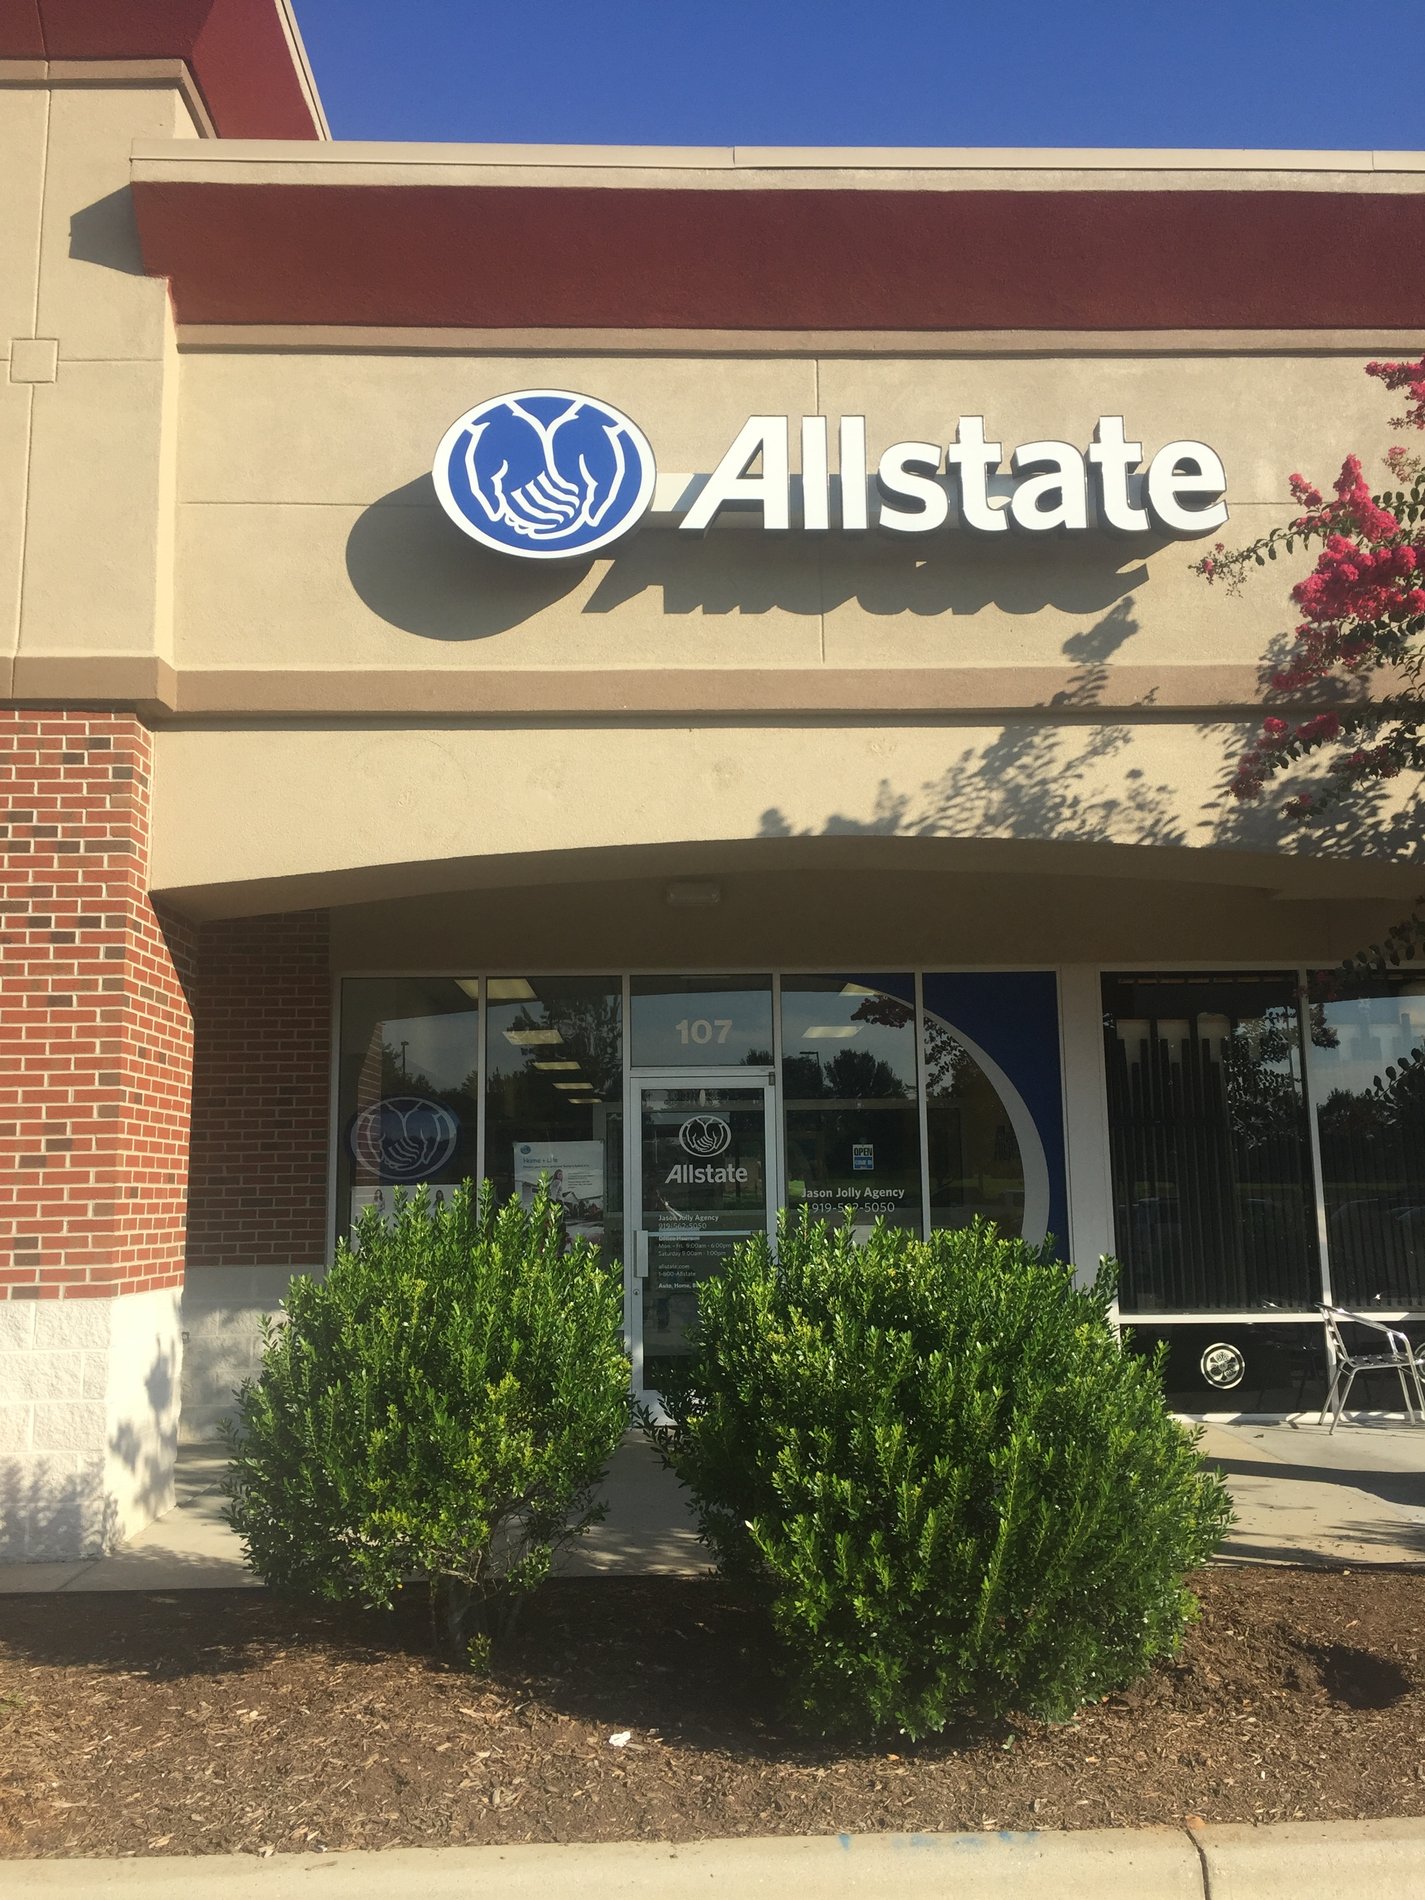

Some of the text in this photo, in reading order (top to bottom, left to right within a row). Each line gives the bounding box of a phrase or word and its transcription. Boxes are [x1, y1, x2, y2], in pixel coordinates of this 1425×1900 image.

[678, 415, 1228, 531] Allstate
[676, 1019, 733, 1044] 107
[854, 1148, 873, 1156] OPEN
[665, 1164, 748, 1183] Allstate
[802, 1186, 905, 1199] Jason Jolly Agency
[695, 1214, 719, 1222] Agency
